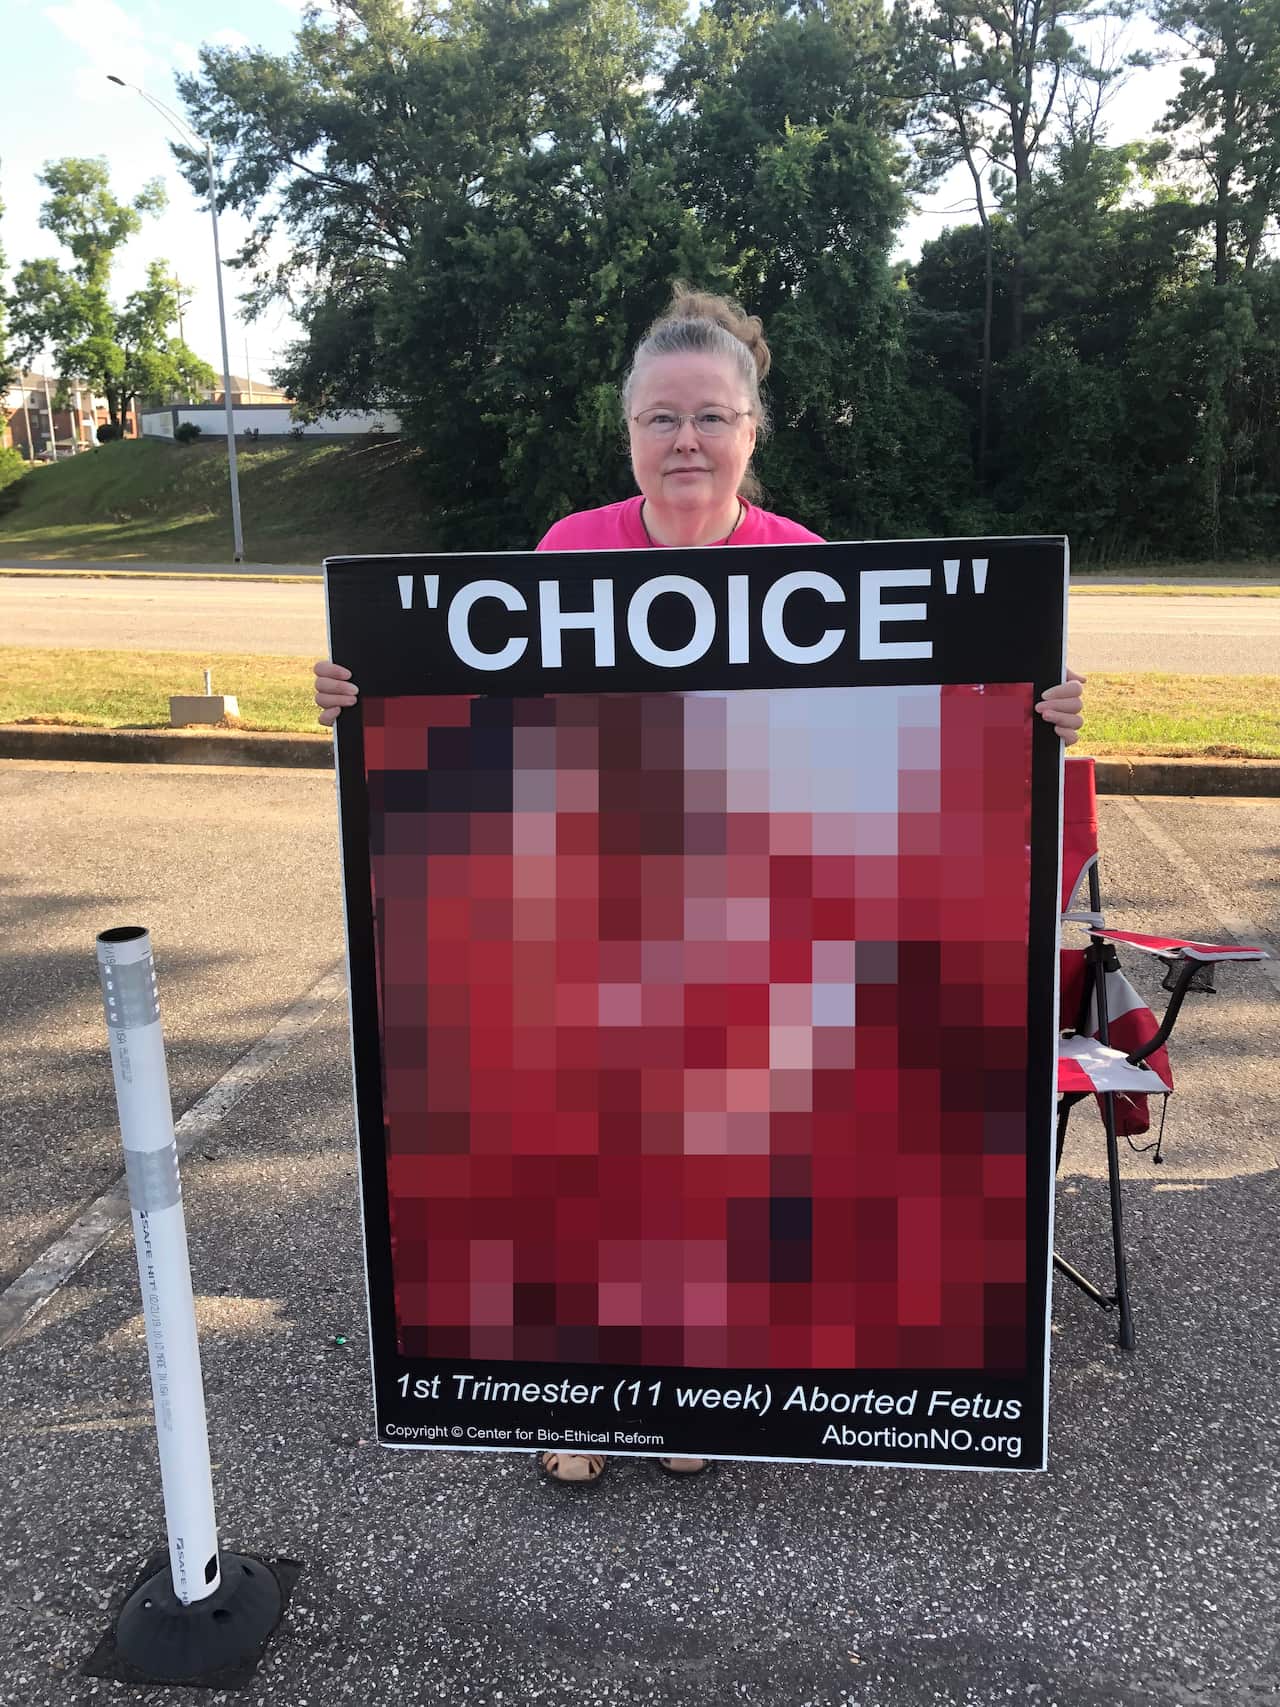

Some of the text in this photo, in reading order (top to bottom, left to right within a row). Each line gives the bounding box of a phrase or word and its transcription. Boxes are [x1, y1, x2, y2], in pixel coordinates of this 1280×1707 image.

[397, 558, 989, 671] "CHOICE"
[142, 1219, 153, 1259] SAFE
[397, 1372, 1023, 1420] 1st Trimester (11 week) Aborted Fetus
[385, 1423, 449, 1440] Copyright
[466, 1426, 513, 1440] Center
[515, 1427, 534, 1441] for
[537, 1428, 610, 1443] Bio-Ethical
[614, 1431, 664, 1445] Reform
[821, 1424, 1022, 1459] AbortionNO.org
[177, 1551, 188, 1585] SAFE
